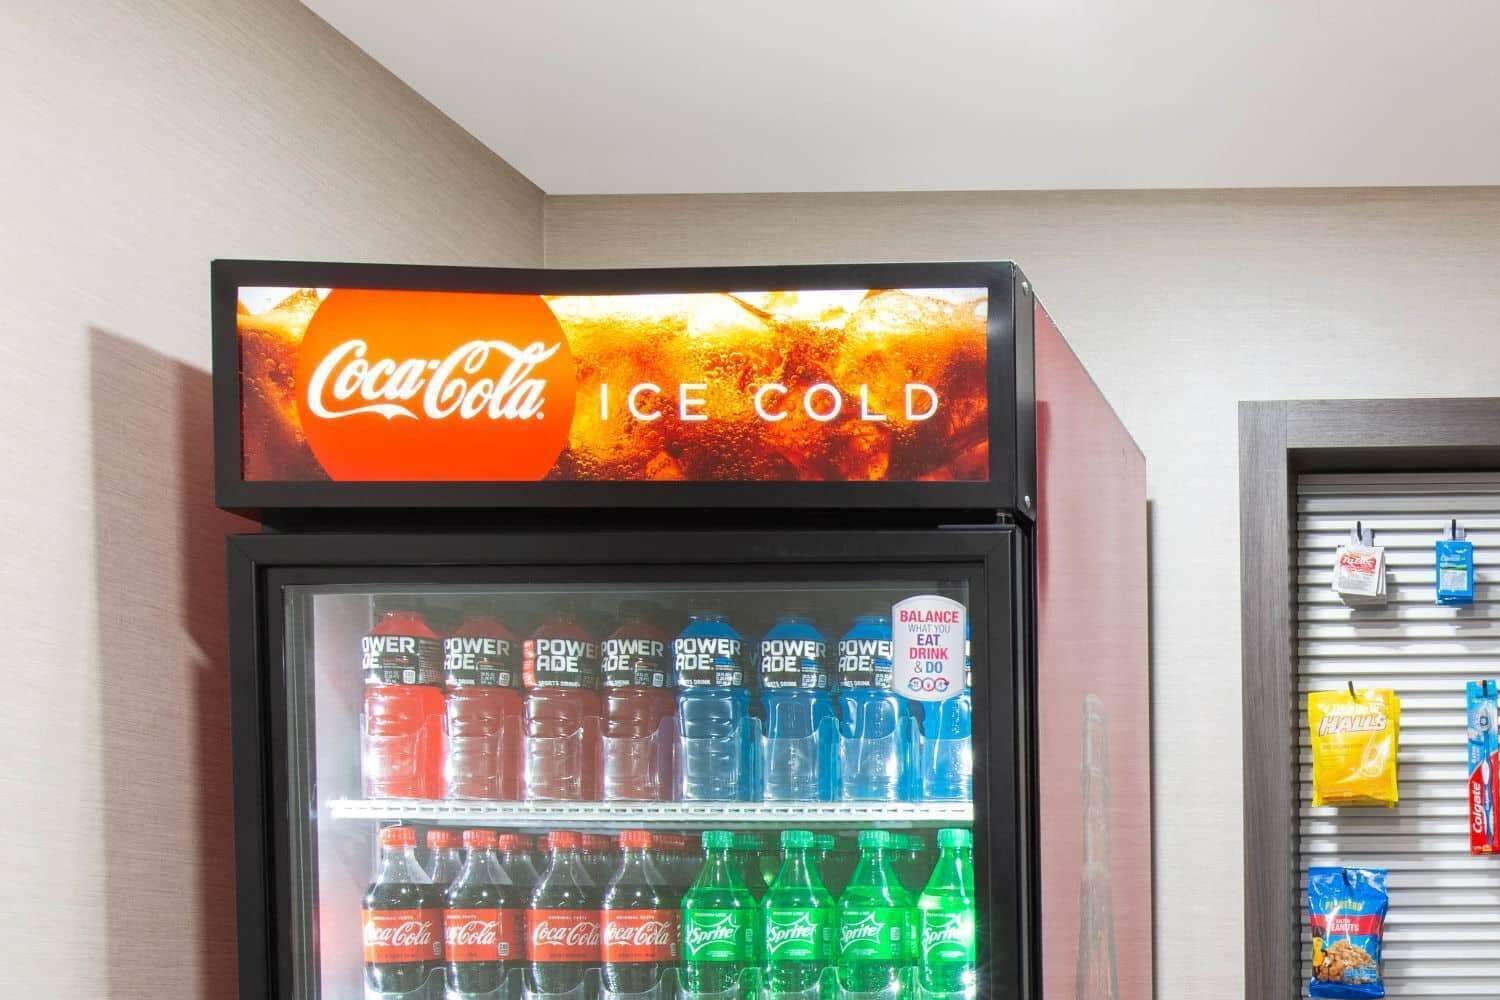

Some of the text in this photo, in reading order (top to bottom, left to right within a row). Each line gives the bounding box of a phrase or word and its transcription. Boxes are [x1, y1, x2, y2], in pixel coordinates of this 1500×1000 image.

[307, 339, 562, 422] Coca-Cola
[601, 383, 941, 423] ICE COLD
[900, 611, 959, 624] BALANCE
[908, 624, 950, 633] WHAT YOU
[362, 637, 415, 653] OWER
[536, 639, 599, 658] POWE
[601, 640, 664, 656] POWER
[674, 638, 741, 655] POWER
[761, 640, 826, 657] POWER
[917, 634, 940, 646] EAT
[838, 640, 893, 658] POWE
[910, 648, 948, 660] DRINK
[362, 653, 382, 669] DE
[914, 661, 943, 673] & DO
[1319, 712, 1387, 736] HALLS
[1472, 782, 1482, 833] Colgate
[534, 920, 600, 946] Coca-Cola
[689, 924, 735, 941] Sprite
[769, 922, 814, 941] Sprite
[841, 922, 881, 941] Sprite
